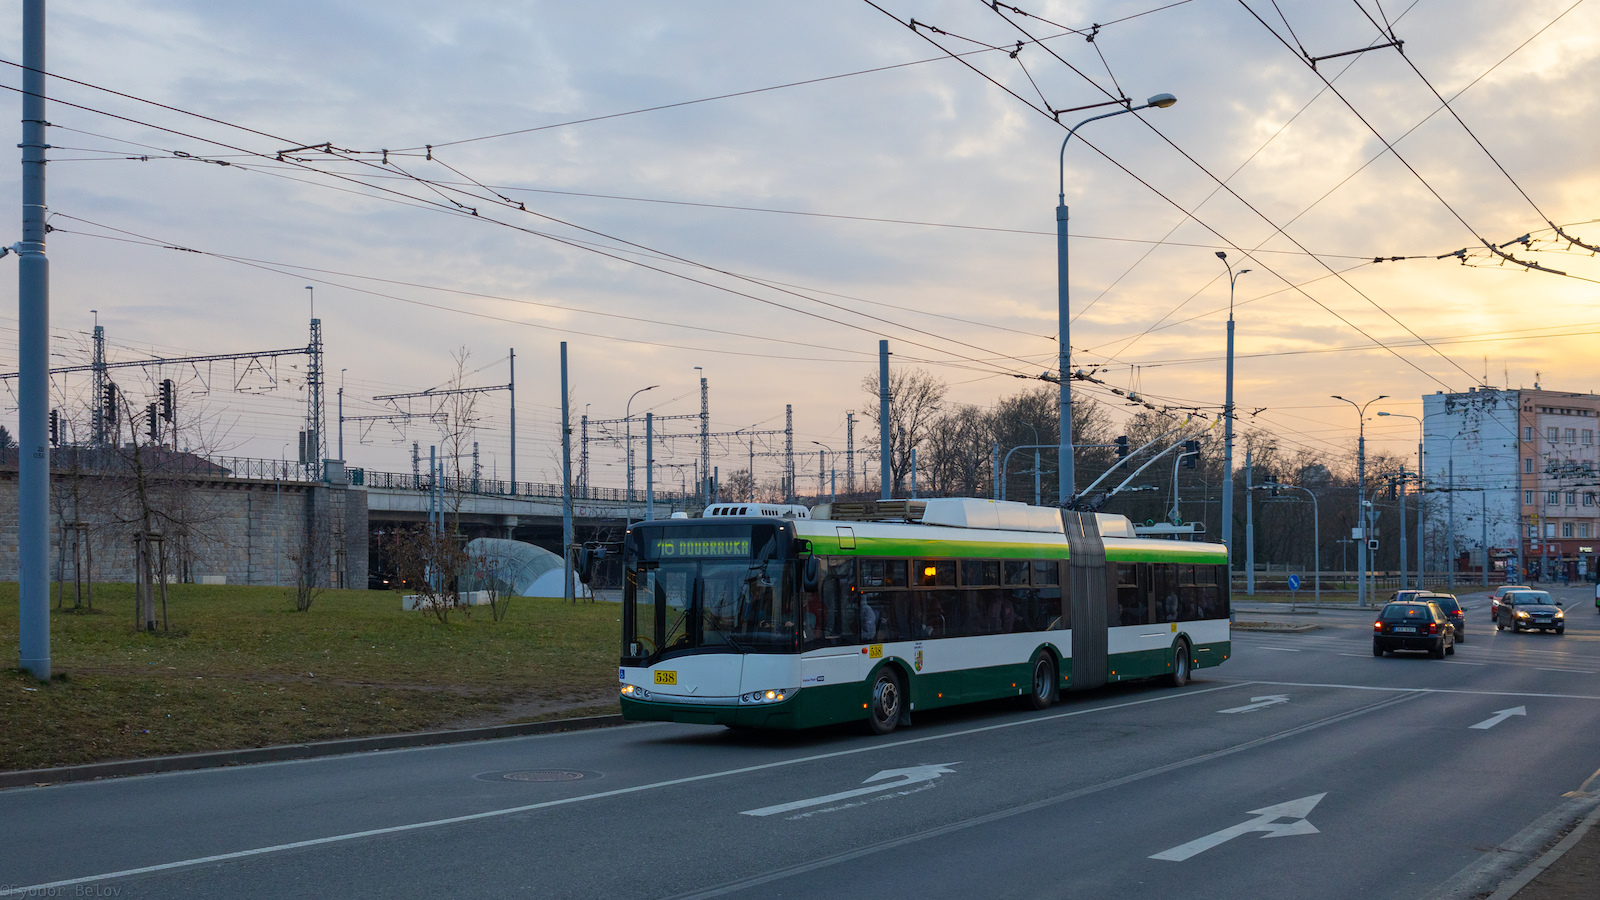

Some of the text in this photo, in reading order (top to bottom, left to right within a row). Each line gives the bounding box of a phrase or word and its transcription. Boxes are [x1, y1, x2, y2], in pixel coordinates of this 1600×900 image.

[657, 539, 749, 556] 16 DOUBRAVKA
[870, 646, 882, 657] 538
[656, 672, 675, 683] 538
